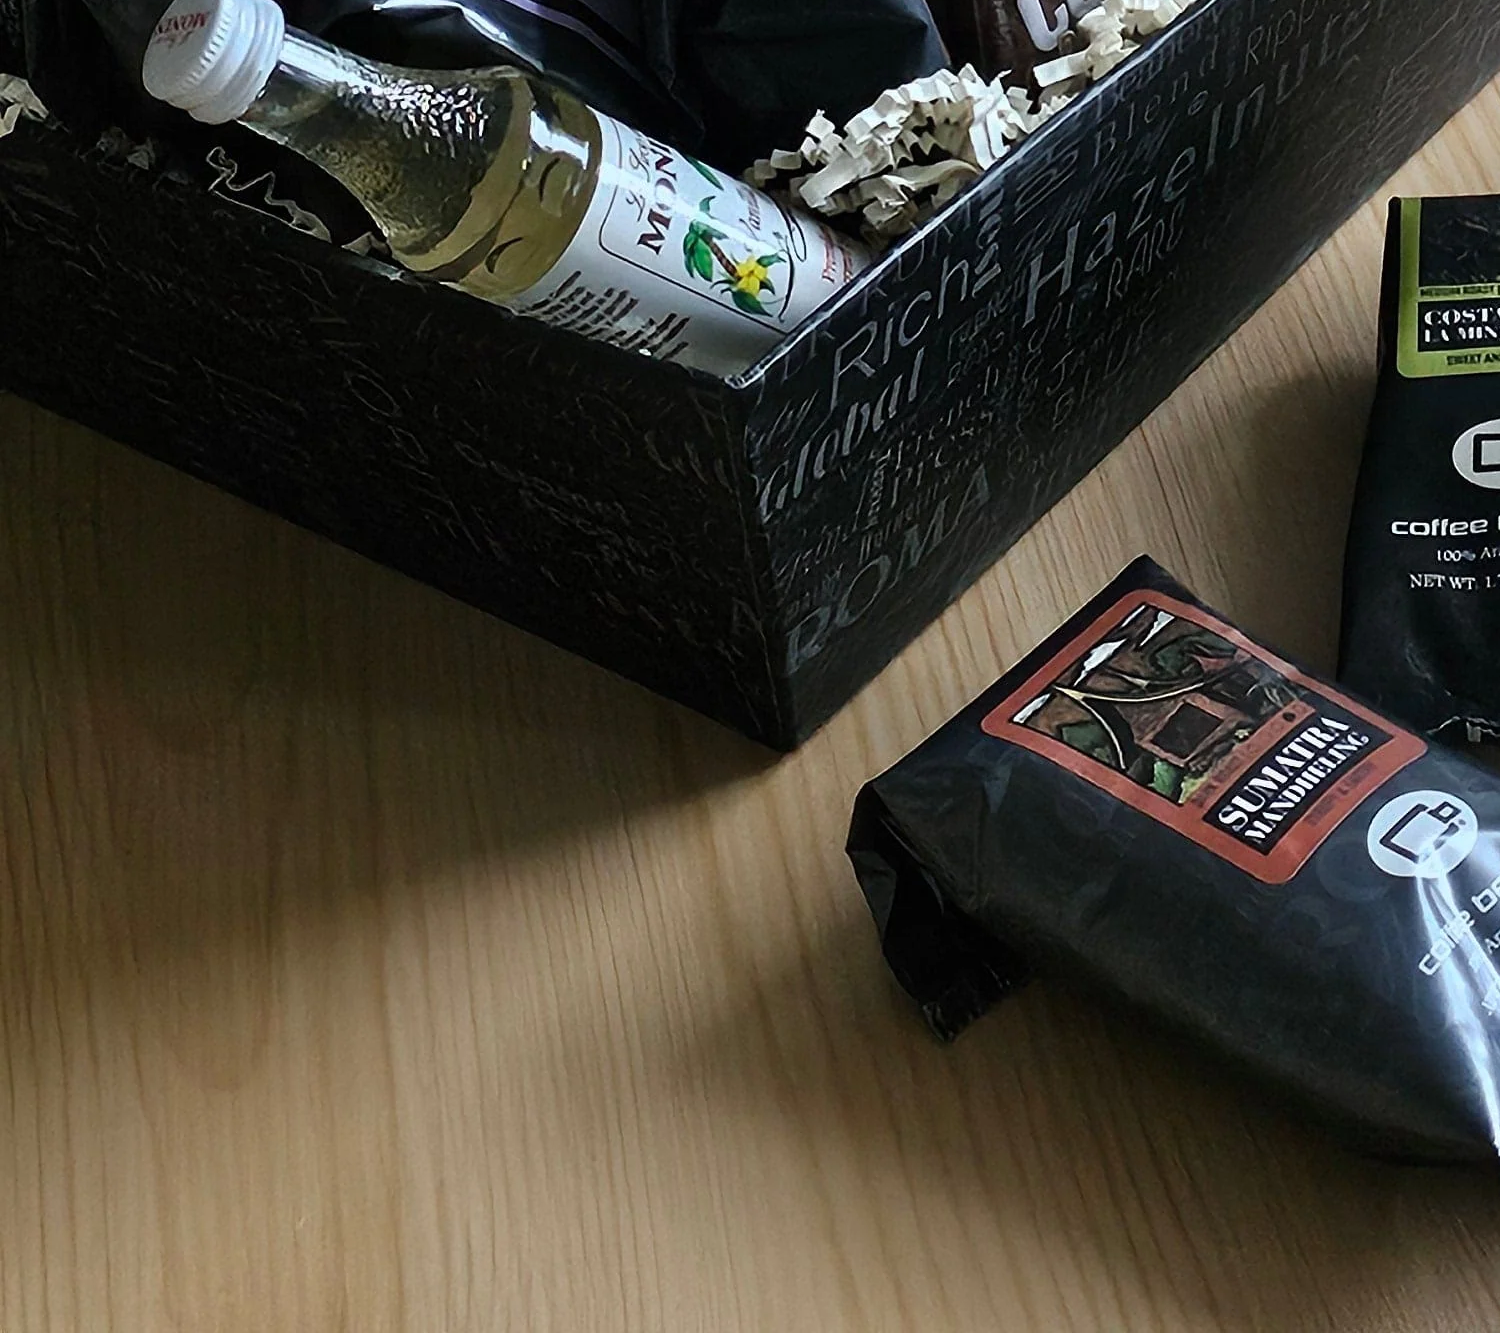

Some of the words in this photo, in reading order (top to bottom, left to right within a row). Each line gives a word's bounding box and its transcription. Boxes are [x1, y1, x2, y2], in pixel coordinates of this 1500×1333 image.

[1424, 328, 1450, 343] LA
[1390, 518, 1489, 537] coffee
[1436, 549, 1476, 562] 100%
[1409, 573, 1446, 588] NET
[1217, 716, 1351, 833] SUMATRA
[1244, 731, 1370, 844] MANDHELING
